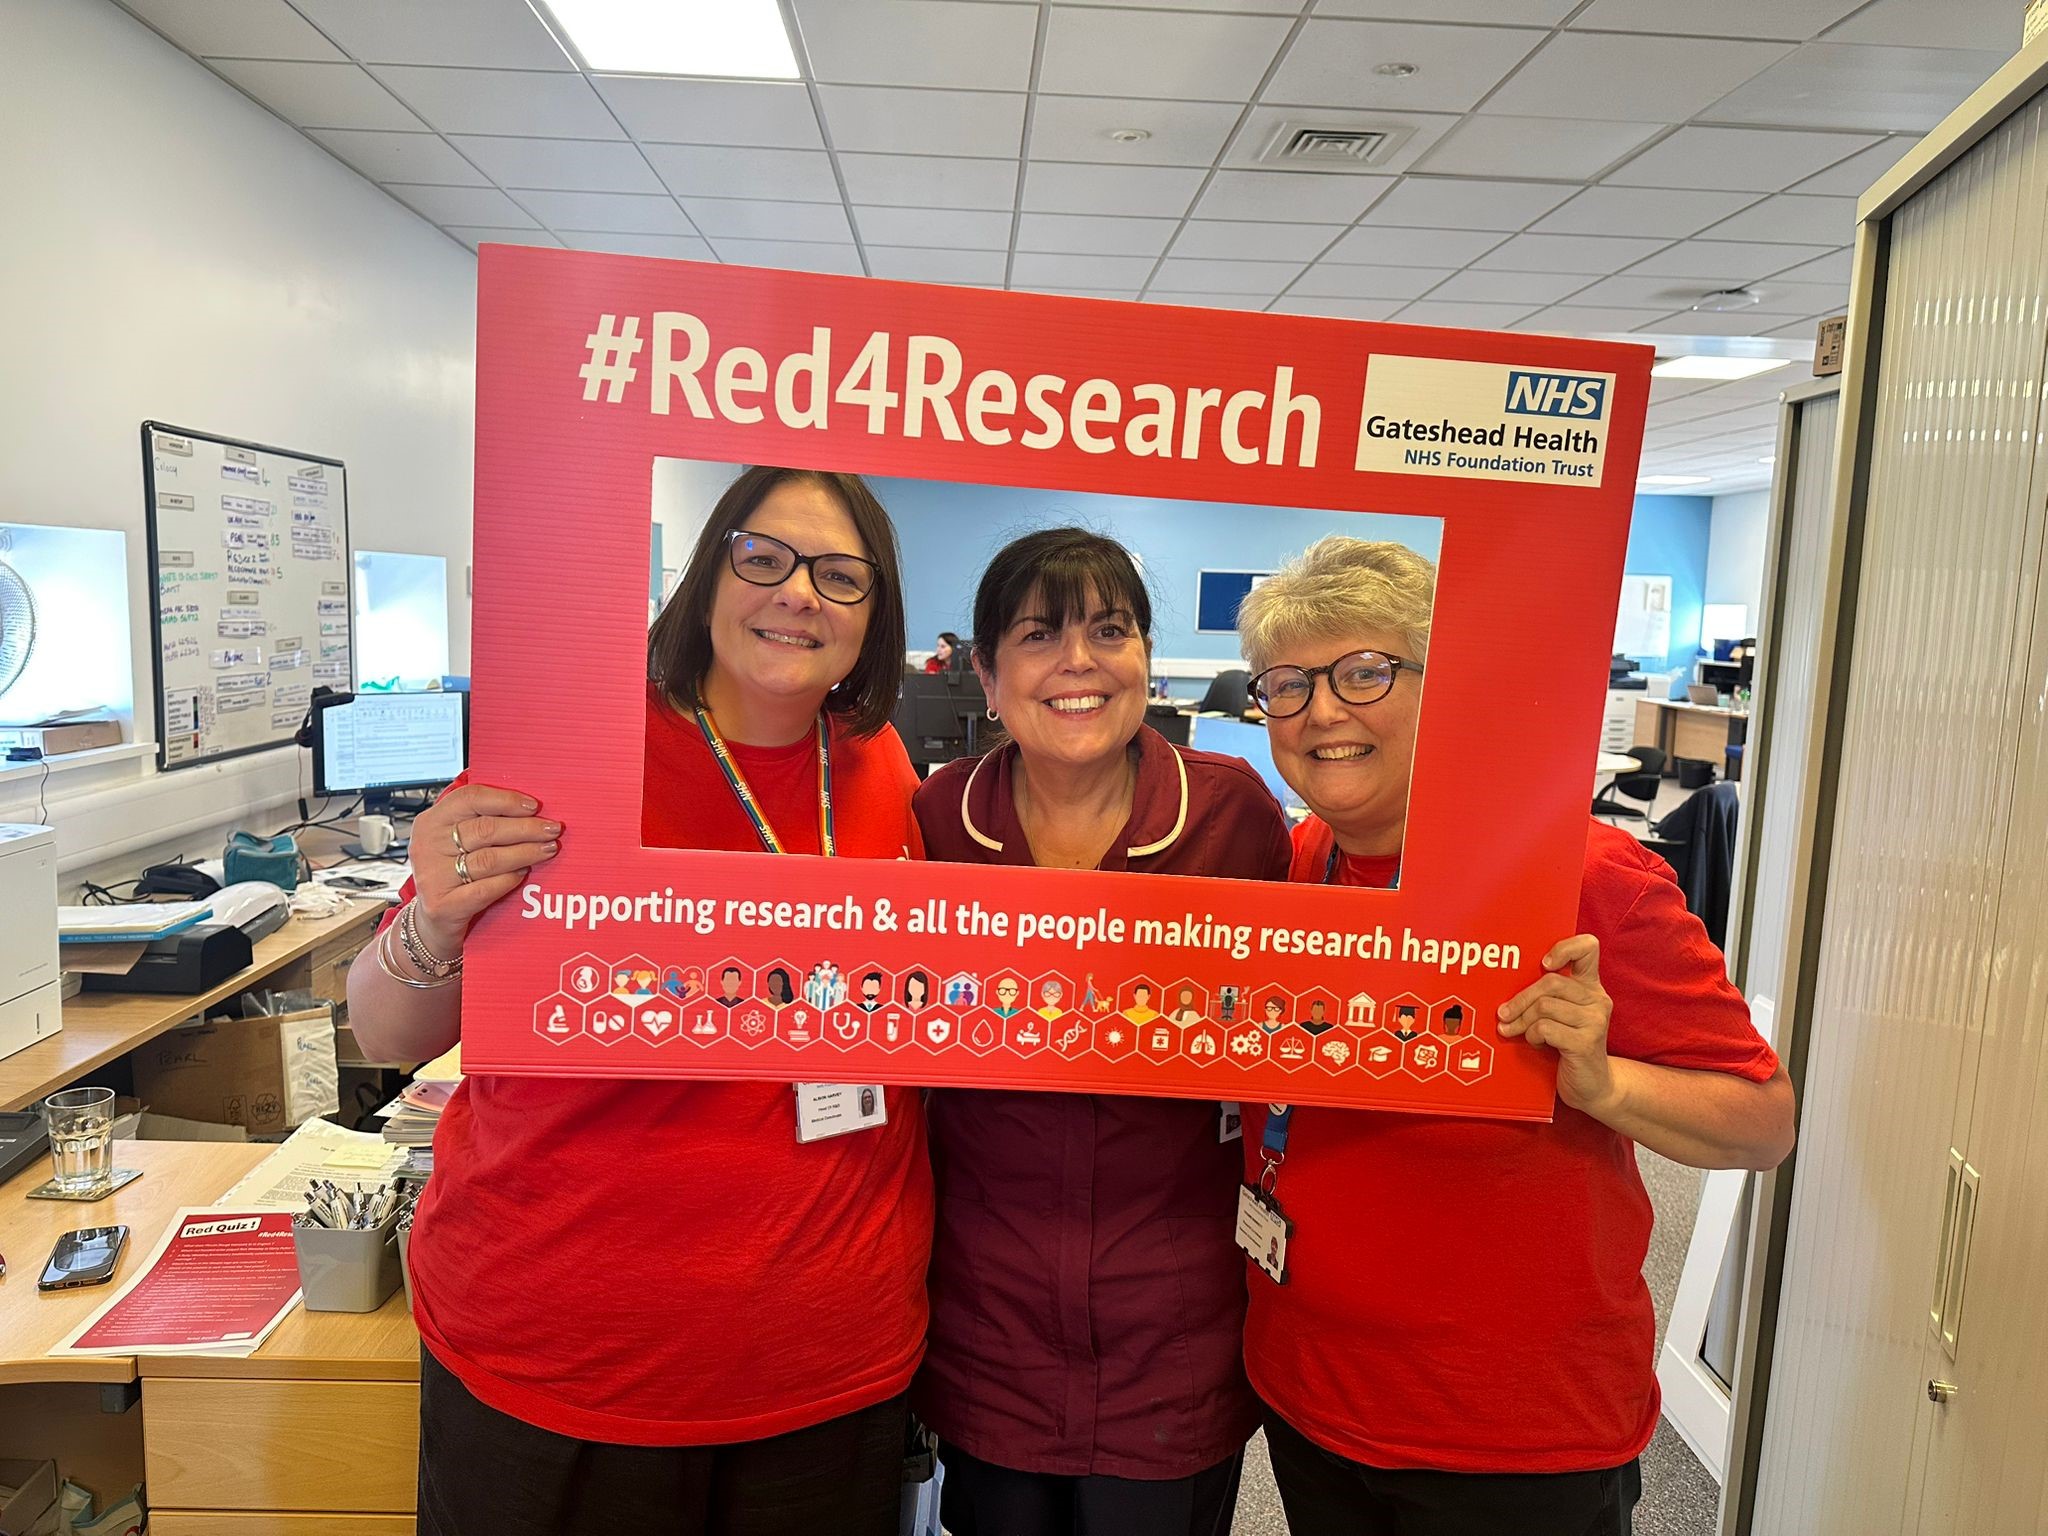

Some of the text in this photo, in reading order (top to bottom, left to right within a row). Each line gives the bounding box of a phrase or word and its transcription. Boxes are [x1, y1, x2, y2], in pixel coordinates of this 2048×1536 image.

[578, 311, 1322, 468] #Red4Research
[1508, 375, 1602, 416] NHS
[1366, 415, 1598, 454] Gateshead Health
[1404, 448, 1594, 477] NHS Foundation Trust
[521, 883, 1520, 975] Supporting research & all the people making research happen
[185, 1225, 213, 1235] Red
[216, 1221, 248, 1232] Quiz
